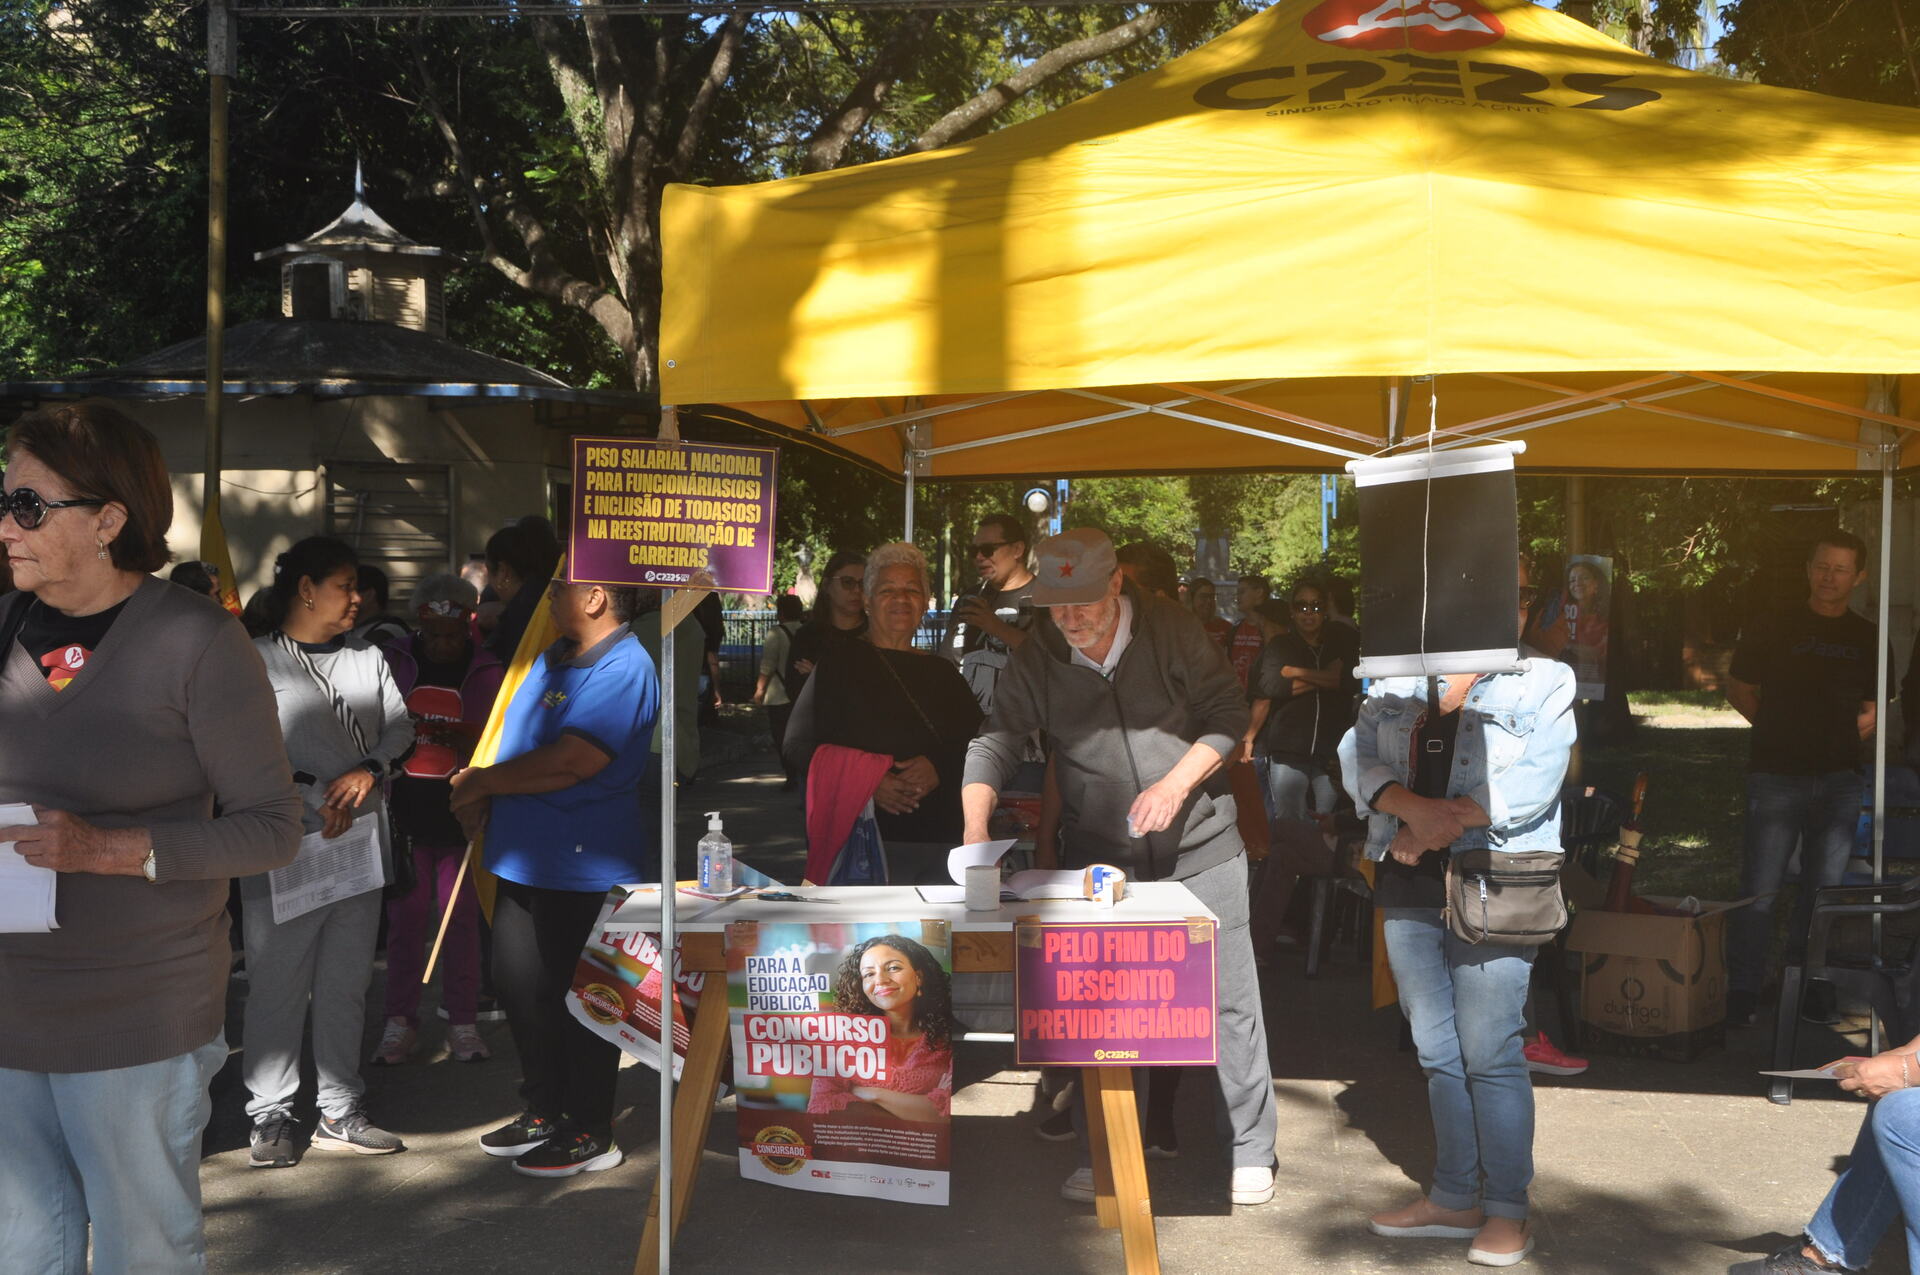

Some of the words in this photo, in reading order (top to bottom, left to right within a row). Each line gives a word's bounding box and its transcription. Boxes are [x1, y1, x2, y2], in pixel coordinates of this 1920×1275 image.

[1265, 98, 1382, 116] SINDICATO
[586, 447, 619, 468] PISO
[621, 448, 688, 471] SALARIAL
[690, 452, 763, 476] NACIONAL
[586, 472, 622, 491] PARA
[626, 472, 761, 500] FUNCIONÁRIAS(OS)
[584, 495, 592, 515] E
[594, 494, 662, 518] INCLUSÃO
[664, 499, 682, 519] DE
[685, 499, 761, 524] TODAS(OS)
[588, 519, 608, 539] NA
[610, 520, 734, 548] REESTRUTURAÇÃO
[737, 526, 756, 547] DE
[629, 545, 709, 568] CARREIRAS
[1044, 931, 1099, 963] PELO
[1103, 931, 1149, 963] FIM
[1153, 930, 1187, 962] DO
[747, 957, 788, 974] PARA
[792, 957, 801, 974] A
[749, 973, 828, 995] EDUCAÇÃO
[1056, 968, 1175, 1001] DESCONTO
[750, 993, 817, 1013] PÚBLICA,
[749, 1015, 887, 1043] CONCURSO
[1022, 1002, 1211, 1040] PREVIDENCIÁRIO
[753, 1037, 887, 1081] PÚBLICO!
[528, 1125, 555, 1139] FILA
[569, 1141, 598, 1160] FILA
